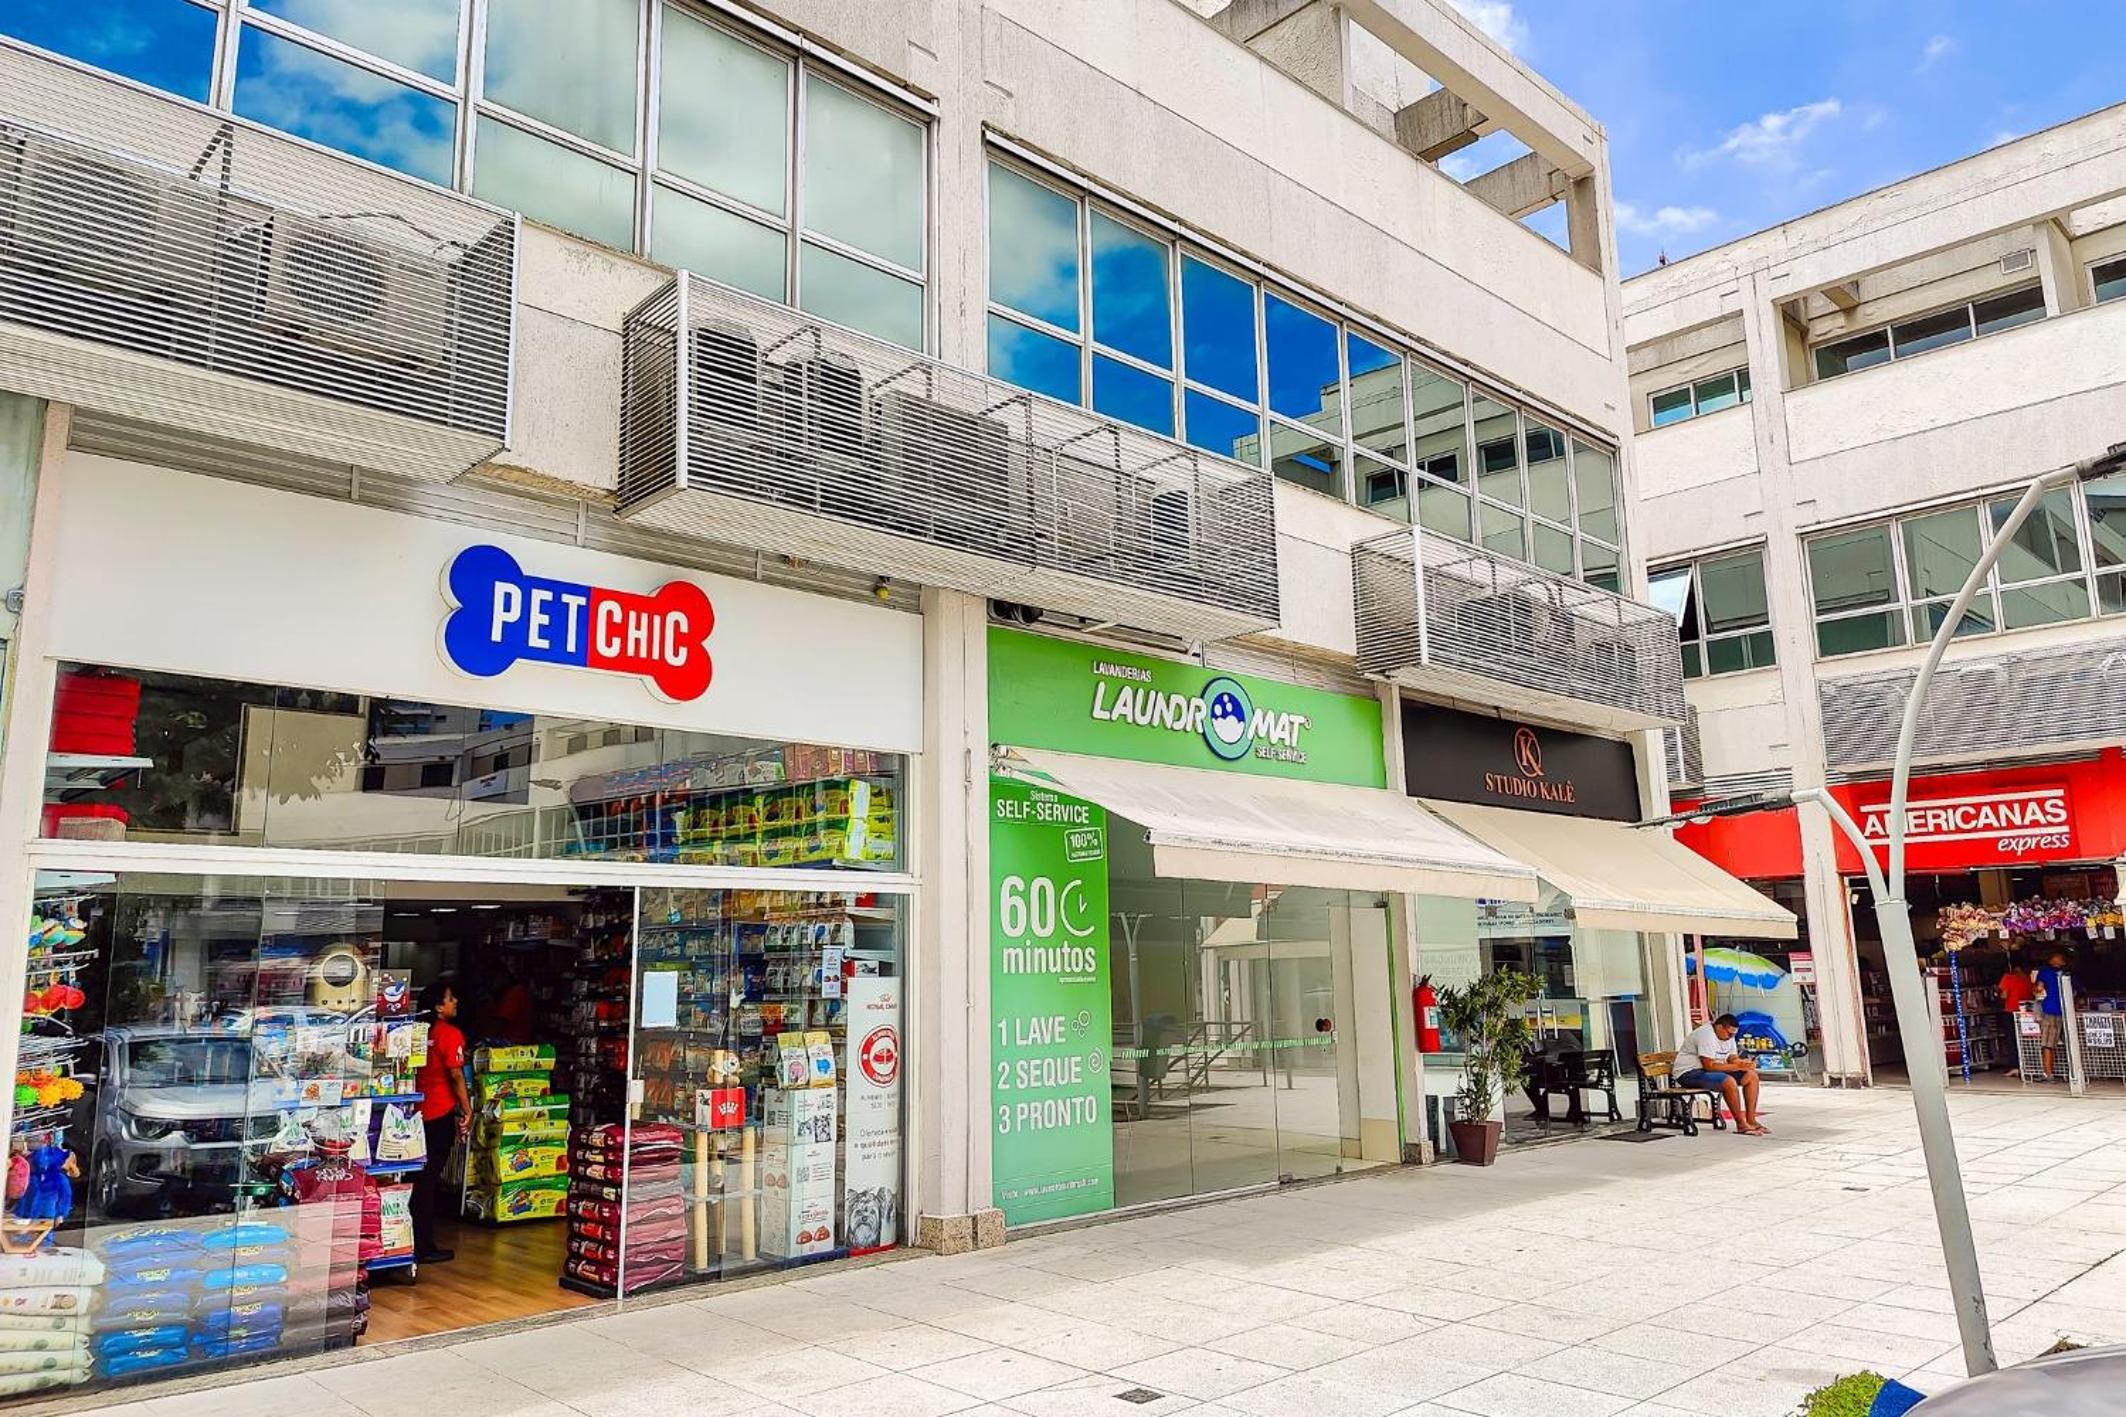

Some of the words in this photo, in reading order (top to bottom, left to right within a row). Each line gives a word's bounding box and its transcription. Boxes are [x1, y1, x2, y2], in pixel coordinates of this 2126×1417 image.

[490, 580, 587, 653] PET
[596, 600, 689, 667] CHIC
[1093, 660, 1152, 682] LAVANDERIAS
[1485, 772, 1538, 799] STUDIO
[1540, 779, 1576, 803] KALÊ
[997, 799, 1089, 824] SELF-SERVICE
[1070, 831, 1099, 849] 100%
[1998, 834, 2071, 856] express
[1000, 876, 1056, 938] 60
[1003, 939, 1097, 974] minutos
[998, 1018, 1008, 1046] 1
[1015, 1016, 1067, 1046] LAVE
[998, 1061, 1010, 1090] 2
[1016, 1056, 1083, 1088] SEQUE
[999, 1104, 1011, 1134] 3
[1017, 1095, 1098, 1132] PRONTO
